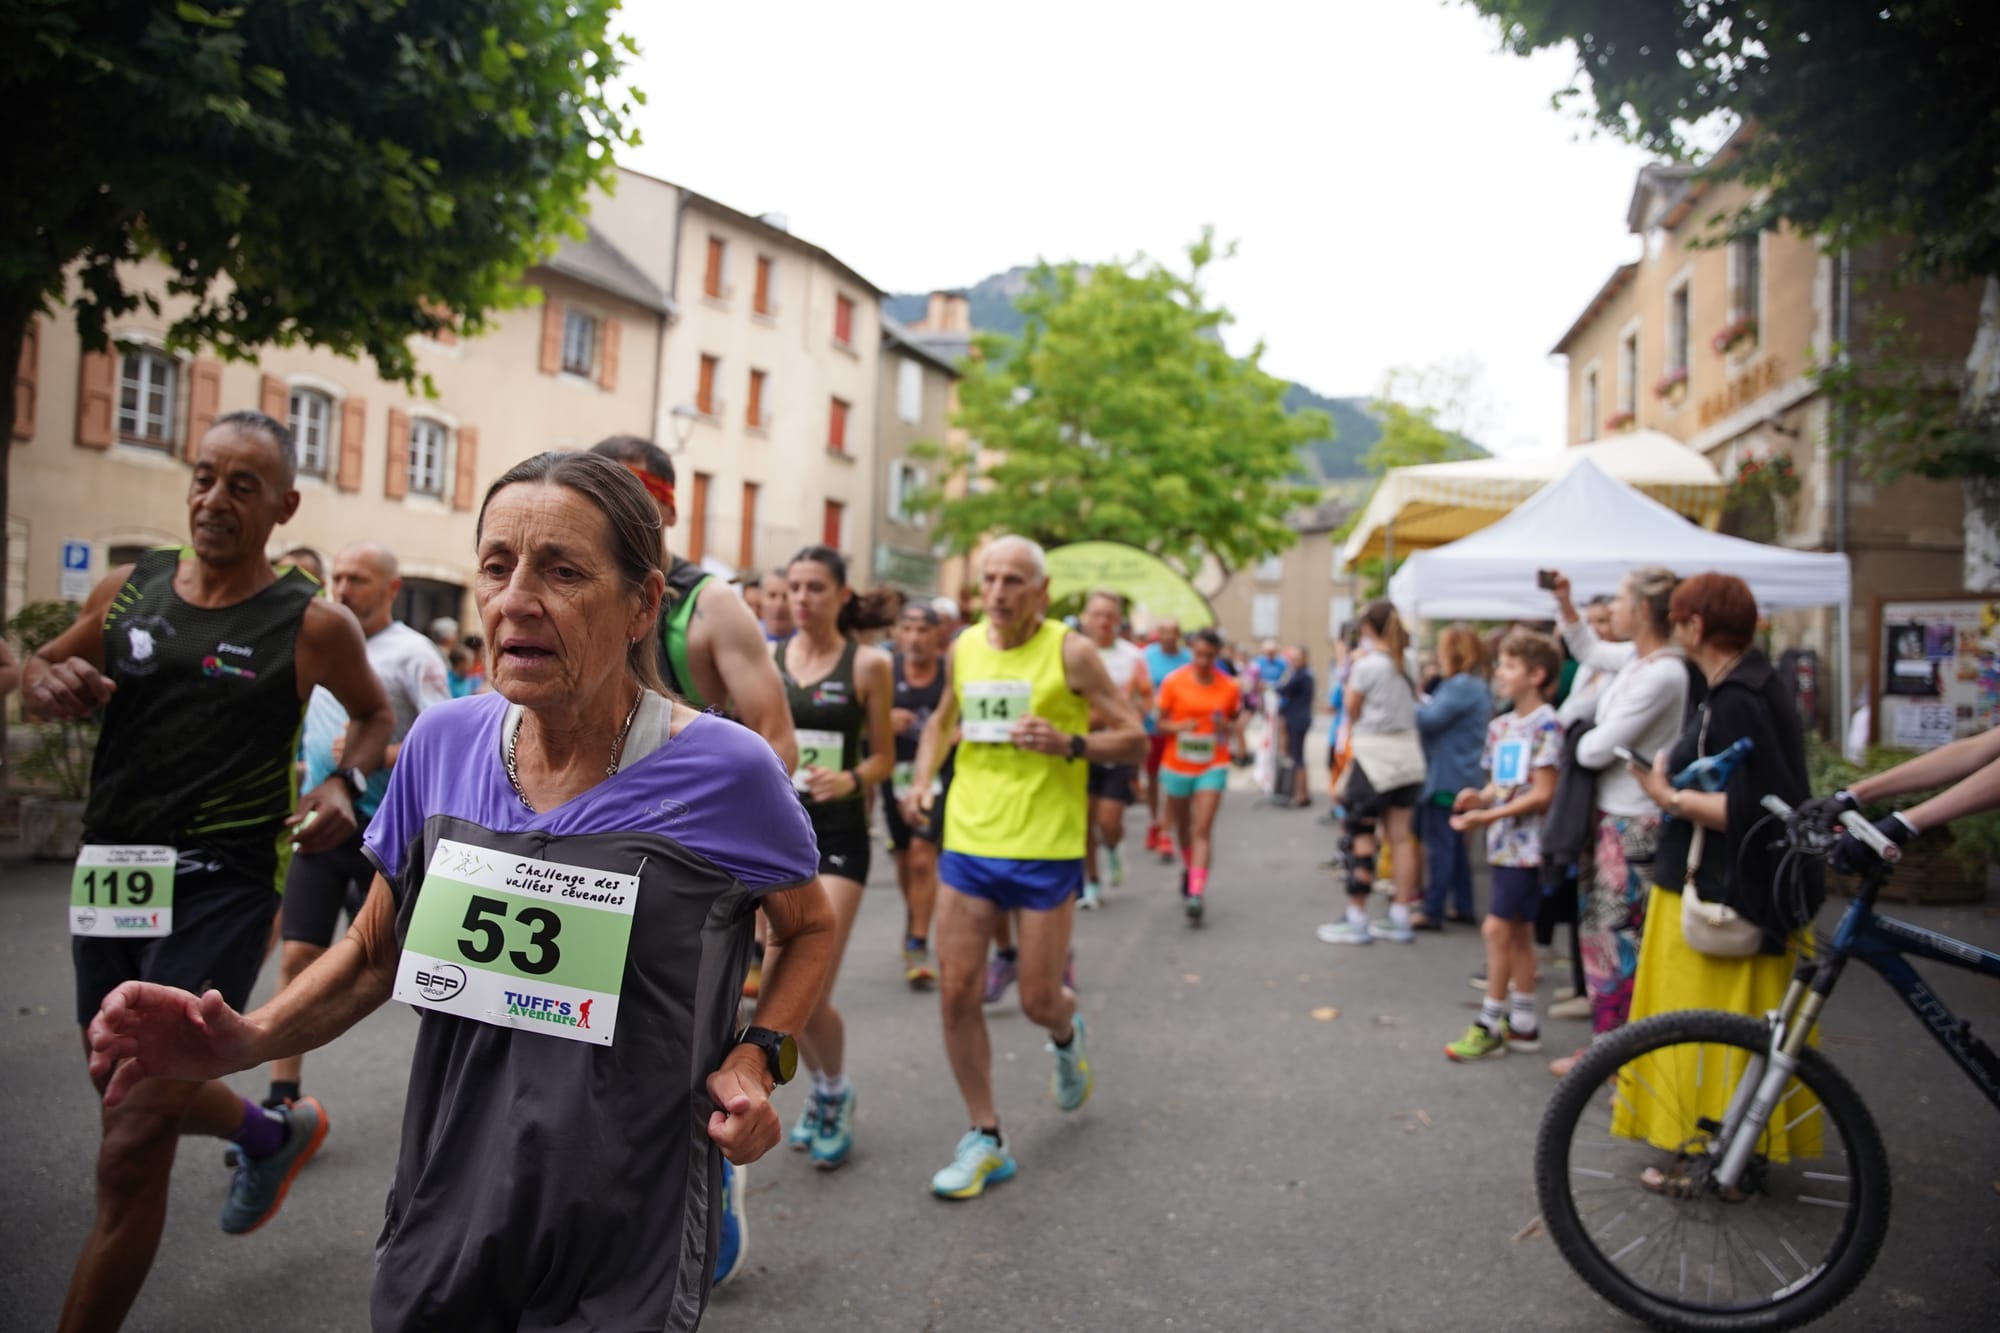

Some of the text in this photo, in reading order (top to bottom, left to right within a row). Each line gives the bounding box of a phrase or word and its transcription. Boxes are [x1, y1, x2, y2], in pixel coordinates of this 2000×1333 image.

[71, 545, 86, 567] P
[978, 697, 1008, 720] 14
[803, 747, 819, 768] 2
[83, 869, 154, 905] 119
[515, 863, 620, 890] Challenge des
[506, 876, 625, 906] vallées cévenoles
[457, 895, 562, 975] 53
[415, 970, 458, 992] BFP
[423, 986, 444, 997] GROUP
[504, 991, 572, 1016] TUFF'S
[508, 1002, 577, 1027] Aventure
